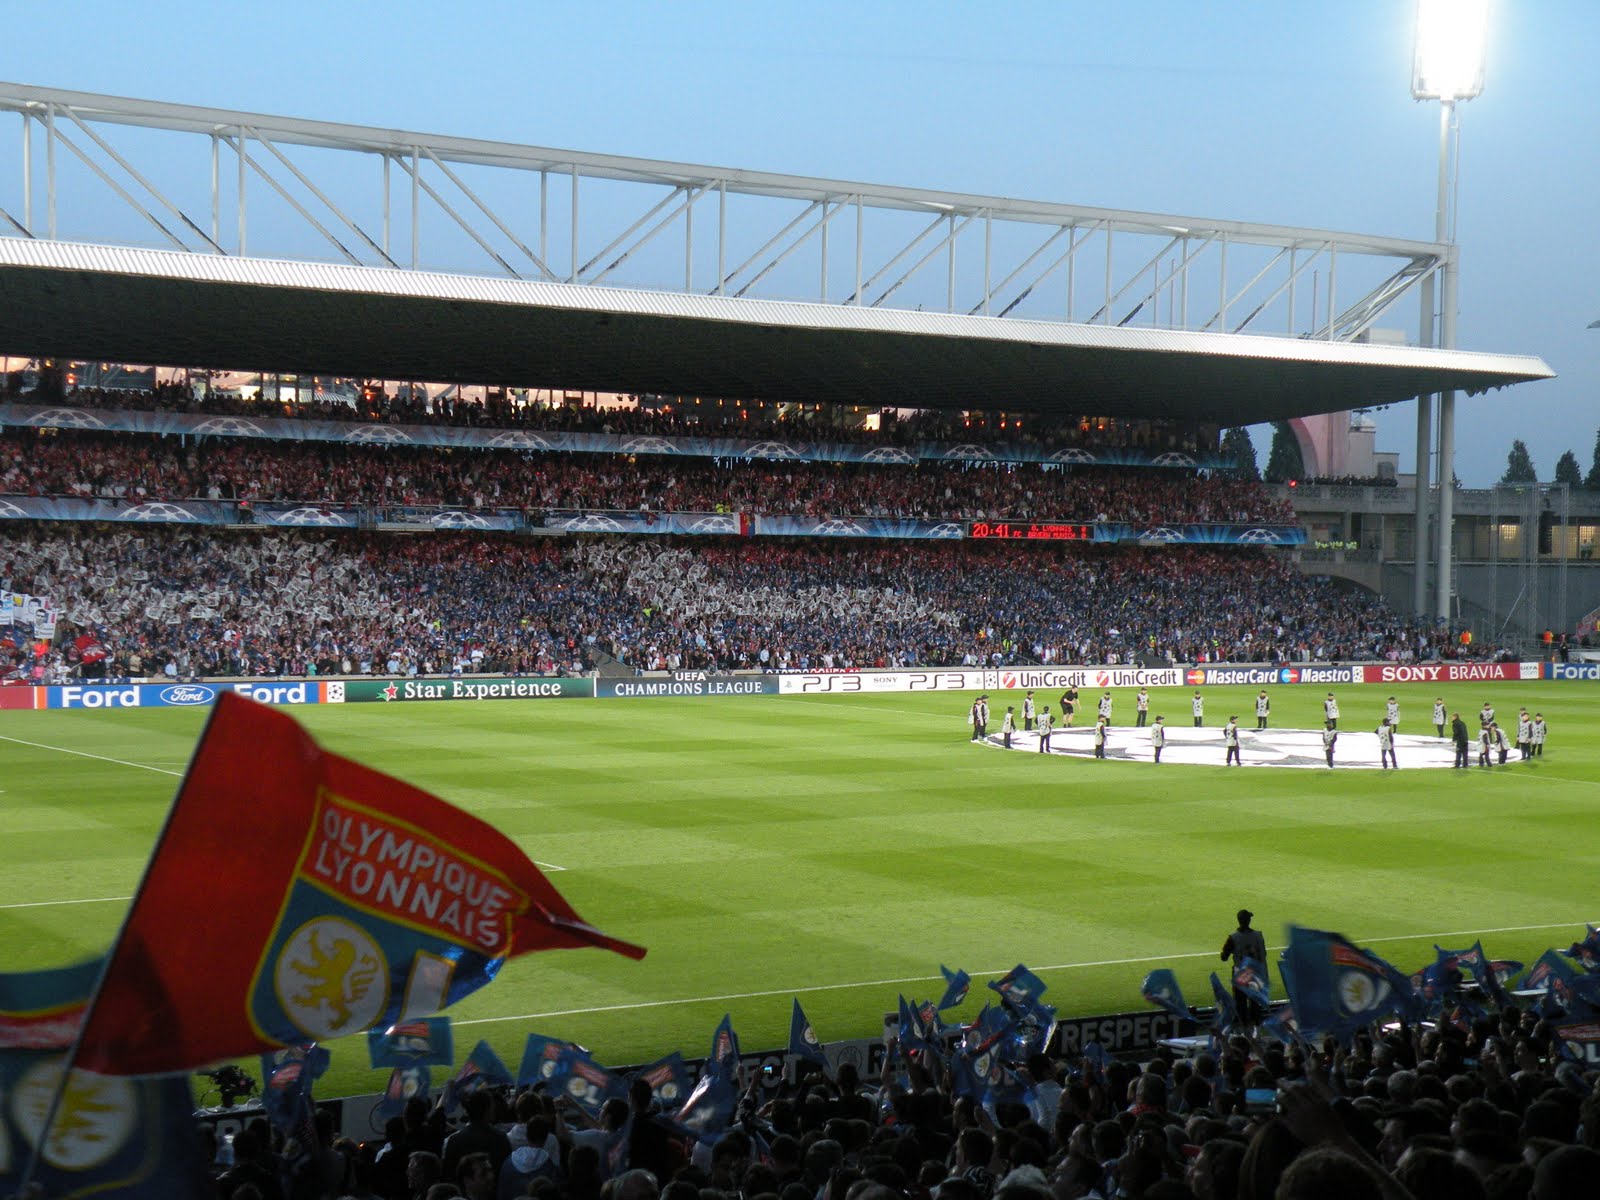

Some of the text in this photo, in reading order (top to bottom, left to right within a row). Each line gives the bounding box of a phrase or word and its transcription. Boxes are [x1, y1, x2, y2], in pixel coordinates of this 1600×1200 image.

[973, 523, 1009, 538] 20:41
[674, 672, 707, 682] UEFA
[1113, 670, 1177, 685] UniCredit
[1206, 669, 1279, 685] MasterCard
[1300, 668, 1351, 683] Maestro
[1382, 665, 1505, 682] SONY BRAVIA
[1552, 663, 1600, 680] Ford
[802, 676, 862, 692] PS3
[909, 674, 965, 690] PS3
[1020, 672, 1087, 688] UniCredit
[62, 686, 140, 708] Ford
[170, 687, 204, 702] Ford
[404, 680, 562, 701] Star Experience
[614, 682, 763, 696] CHAMPIONS LEAGUE
[324, 808, 512, 917] OLYMPIQUE
[315, 840, 500, 948] LYONNAIS
[1060, 1014, 1183, 1056] RESPECT
